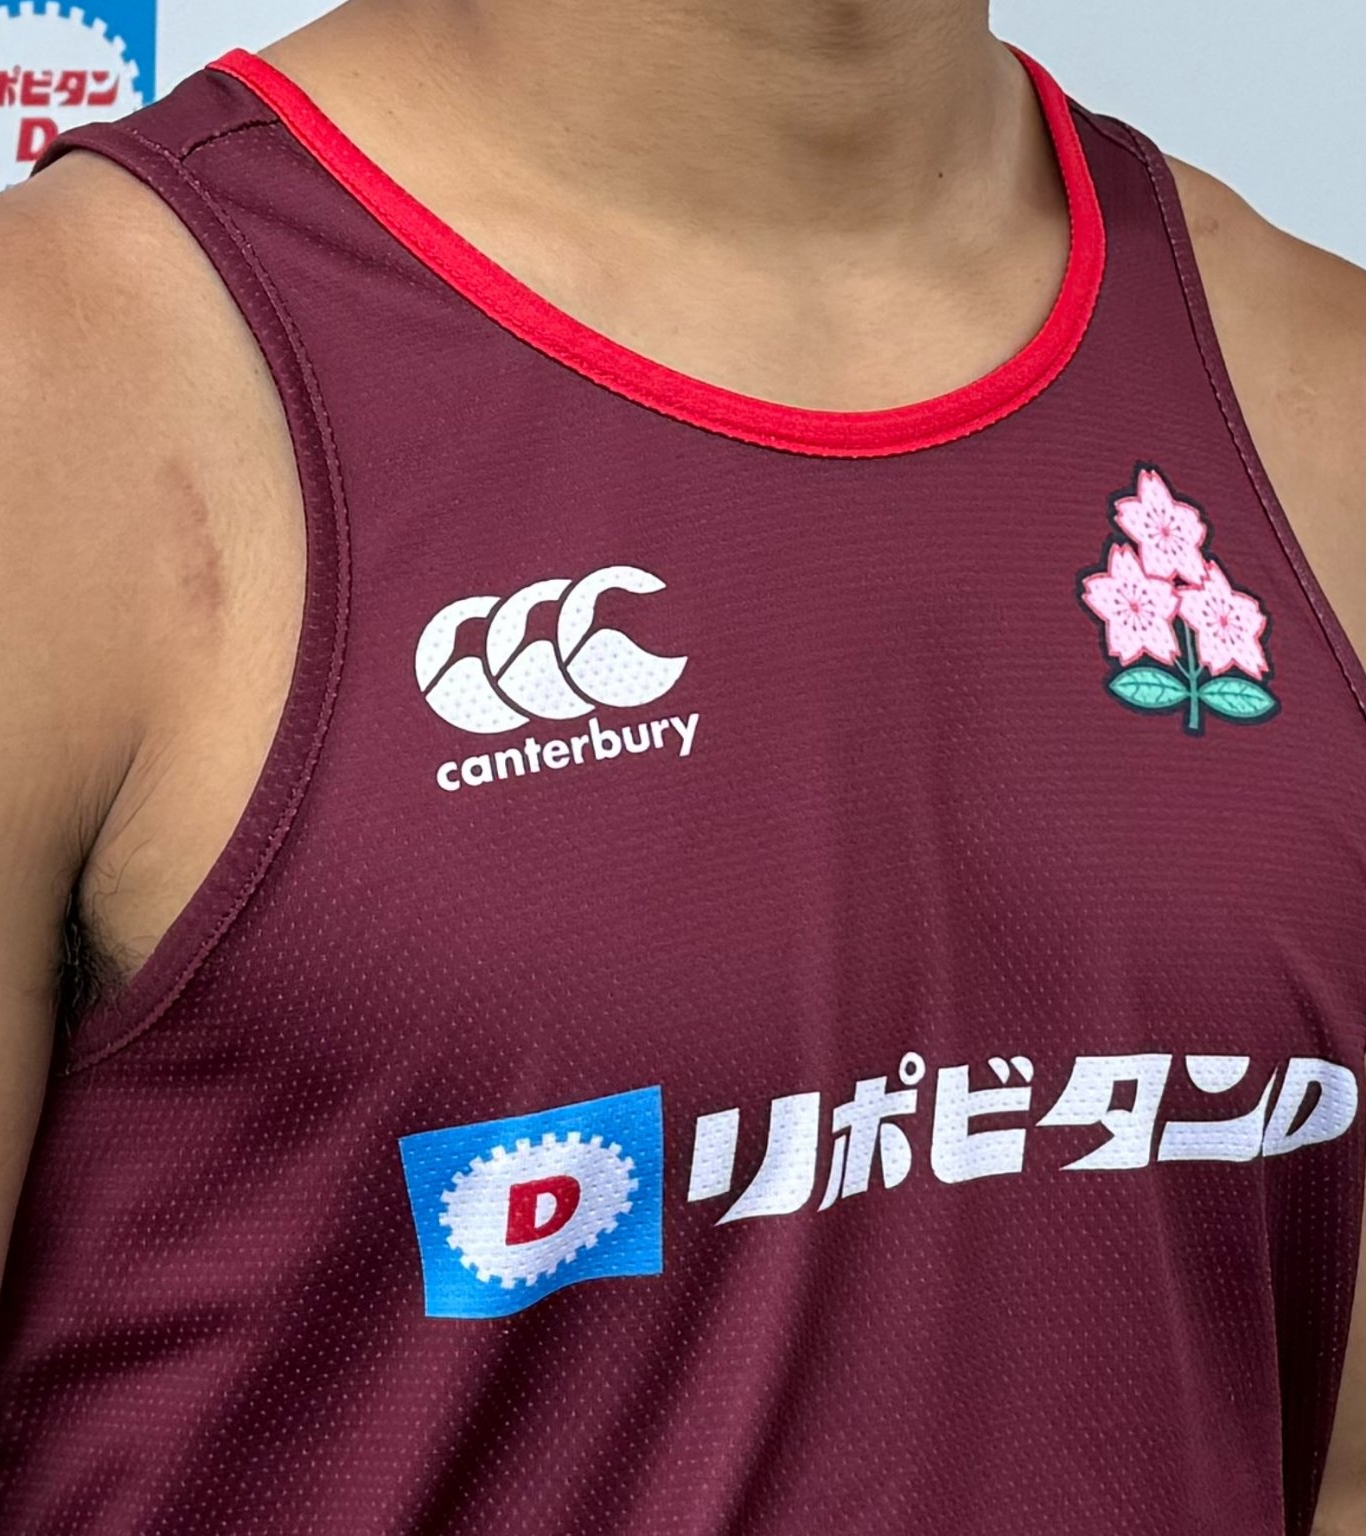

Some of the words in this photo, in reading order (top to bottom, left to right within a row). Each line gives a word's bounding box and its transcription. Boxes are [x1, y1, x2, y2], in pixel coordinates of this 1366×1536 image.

[15, 116, 57, 164] D
[434, 711, 701, 794] canterbury
[686, 1049, 1361, 1228] リポビタンD
[503, 1172, 583, 1248] D
